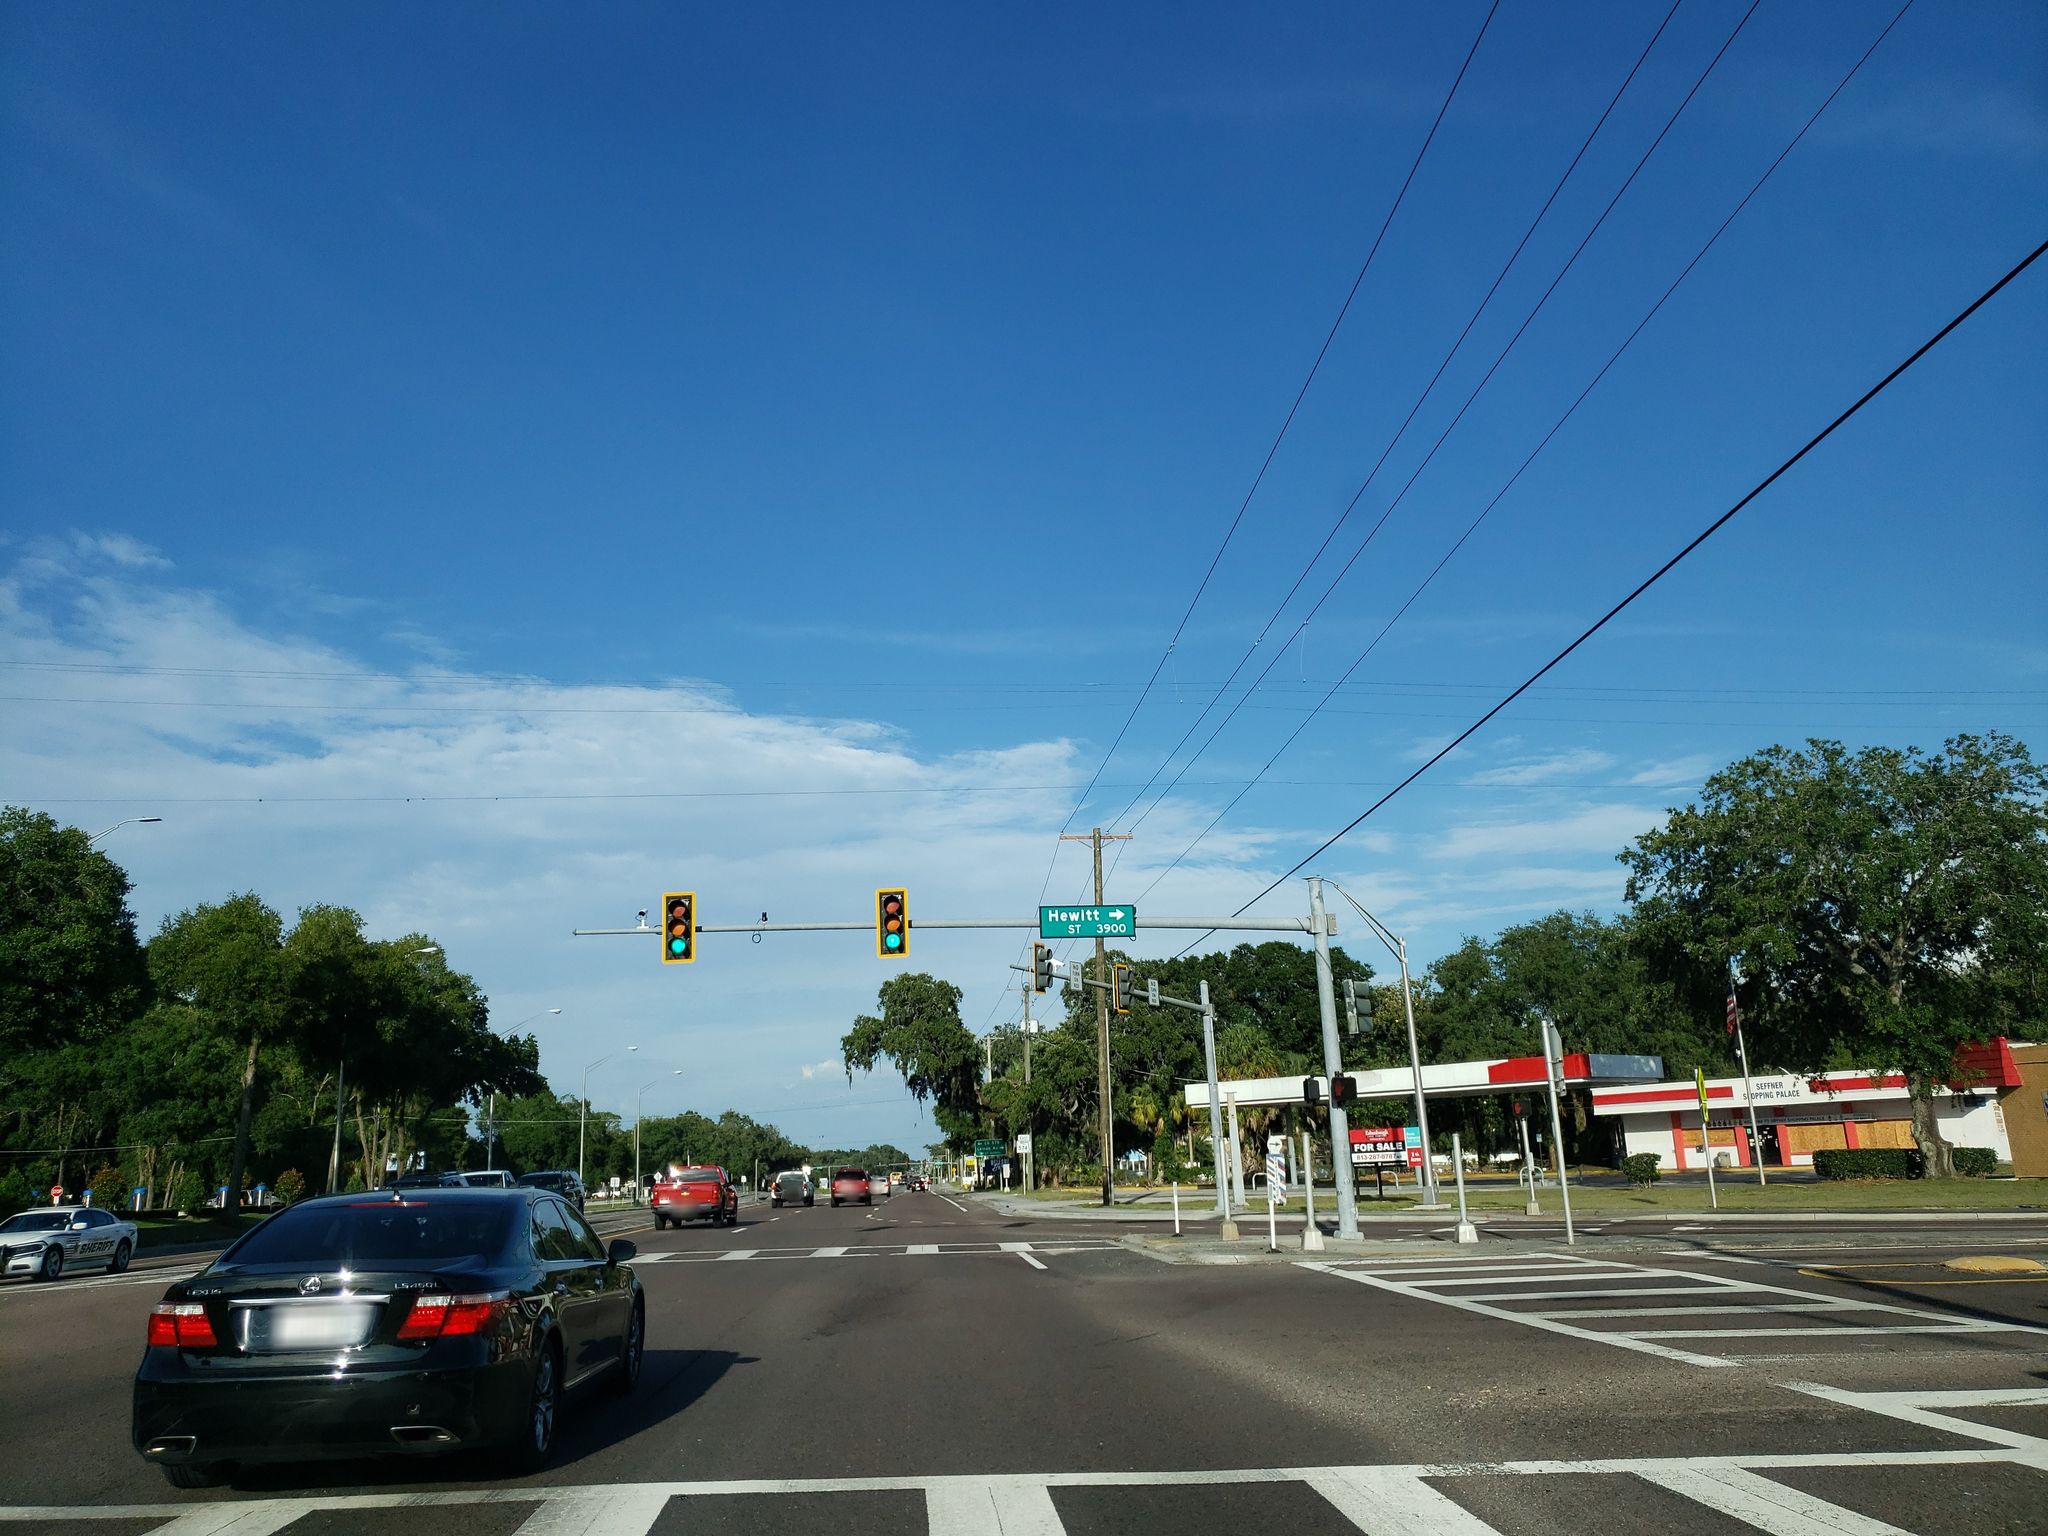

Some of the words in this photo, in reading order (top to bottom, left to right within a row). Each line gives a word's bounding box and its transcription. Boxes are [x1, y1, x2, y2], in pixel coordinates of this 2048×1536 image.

[1048, 909, 1100, 922] Hewitt
[1067, 924, 1082, 934] ST
[1096, 923, 1127, 934] 3900
[1755, 1081, 1784, 1091] SEFFNER
[1743, 1091, 1774, 1100] SOPPING
[1776, 1090, 1800, 1098] PALACE
[1353, 1143, 1375, 1152] FOR
[1376, 1142, 1403, 1151] SALE
[80, 1240, 115, 1254] SHERIFF
